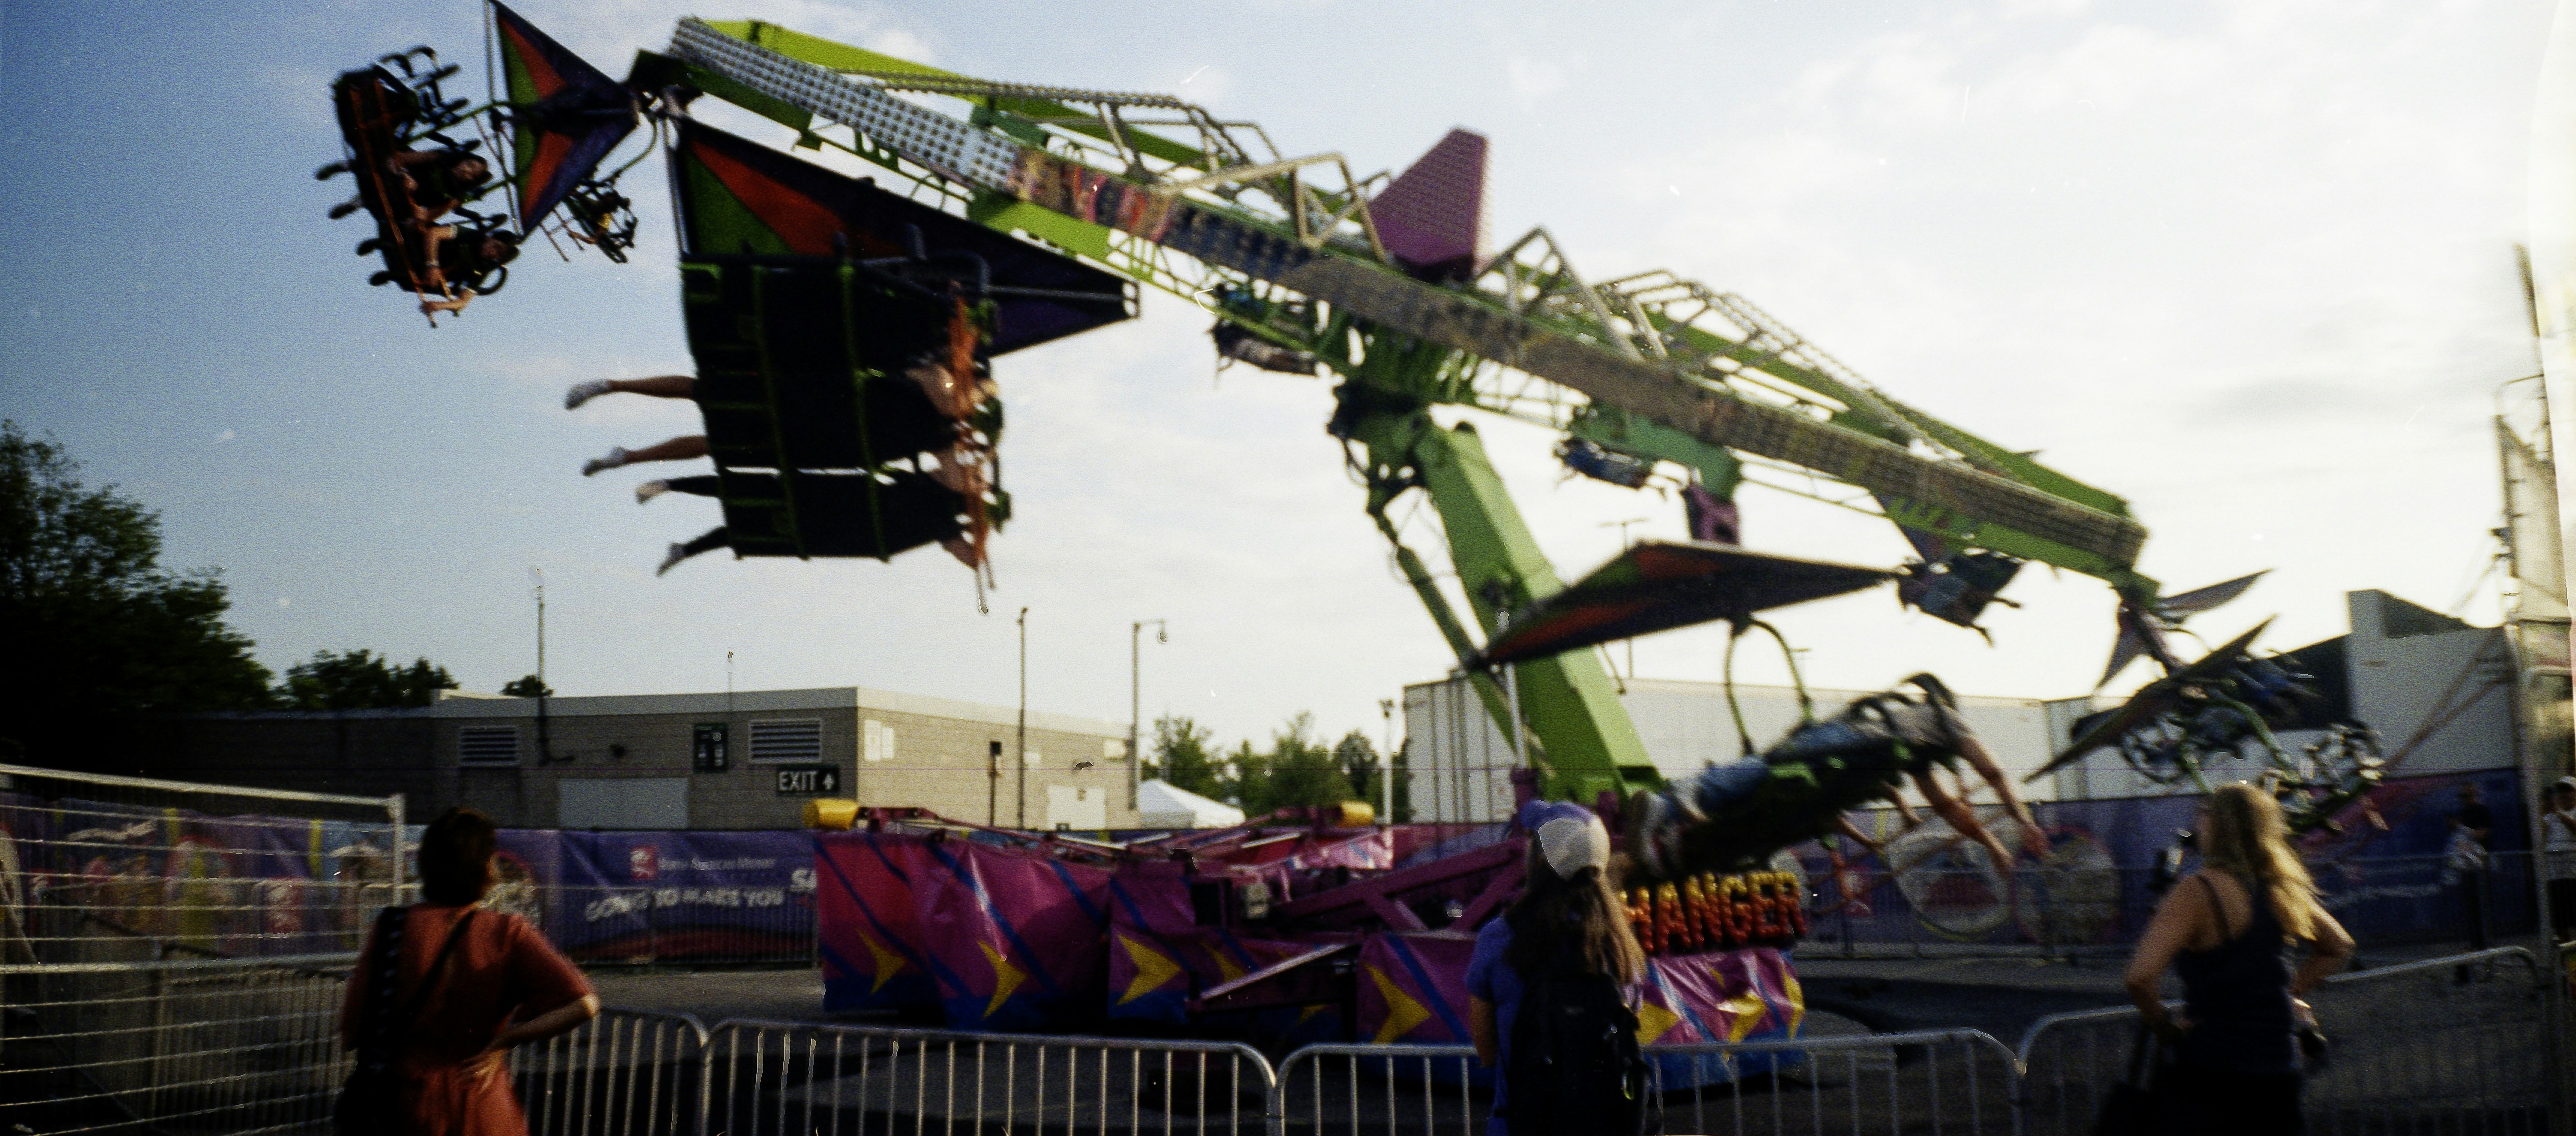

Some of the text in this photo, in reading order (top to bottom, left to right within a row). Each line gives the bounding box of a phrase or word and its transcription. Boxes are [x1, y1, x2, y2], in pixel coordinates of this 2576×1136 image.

[779, 770, 818, 791] EXIT
[585, 889, 782, 922] GOING TO MAKE YOU
[1617, 871, 1805, 952] HANGER
